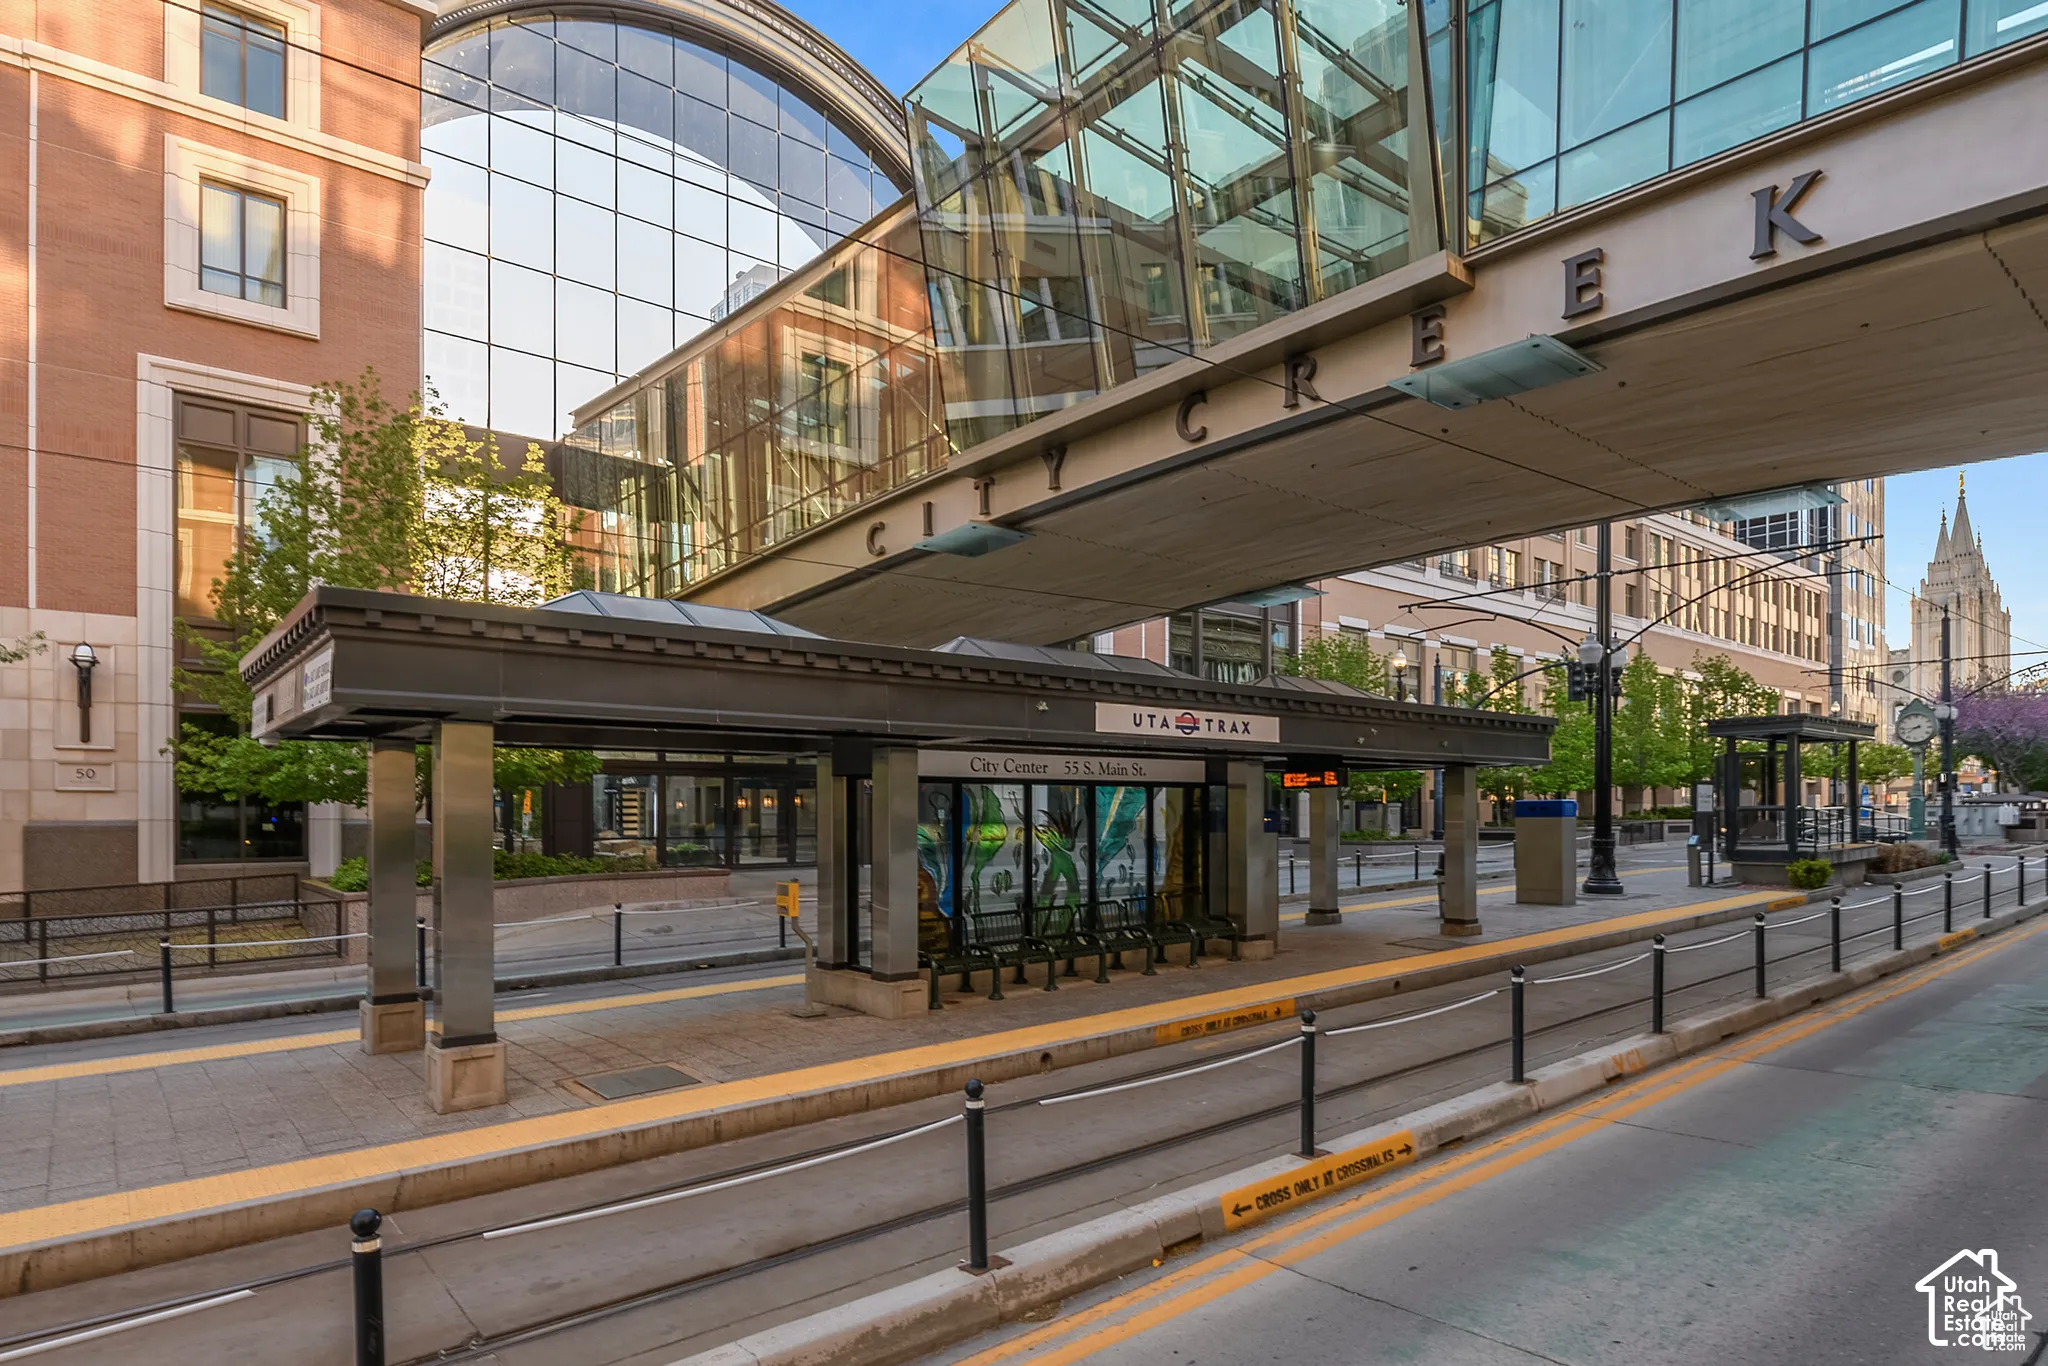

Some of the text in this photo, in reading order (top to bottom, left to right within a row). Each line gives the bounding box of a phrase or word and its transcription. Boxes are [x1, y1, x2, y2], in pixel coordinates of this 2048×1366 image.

[866, 168, 1824, 556] CITY CREEK
[1132, 712, 1251, 735] UTA TRAX
[75, 768, 96, 780] 50
[969, 756, 1147, 777] City Center 55 S. Main St.
[1255, 1148, 1395, 1211] CROSS ONLY AT CROSSWALKS
